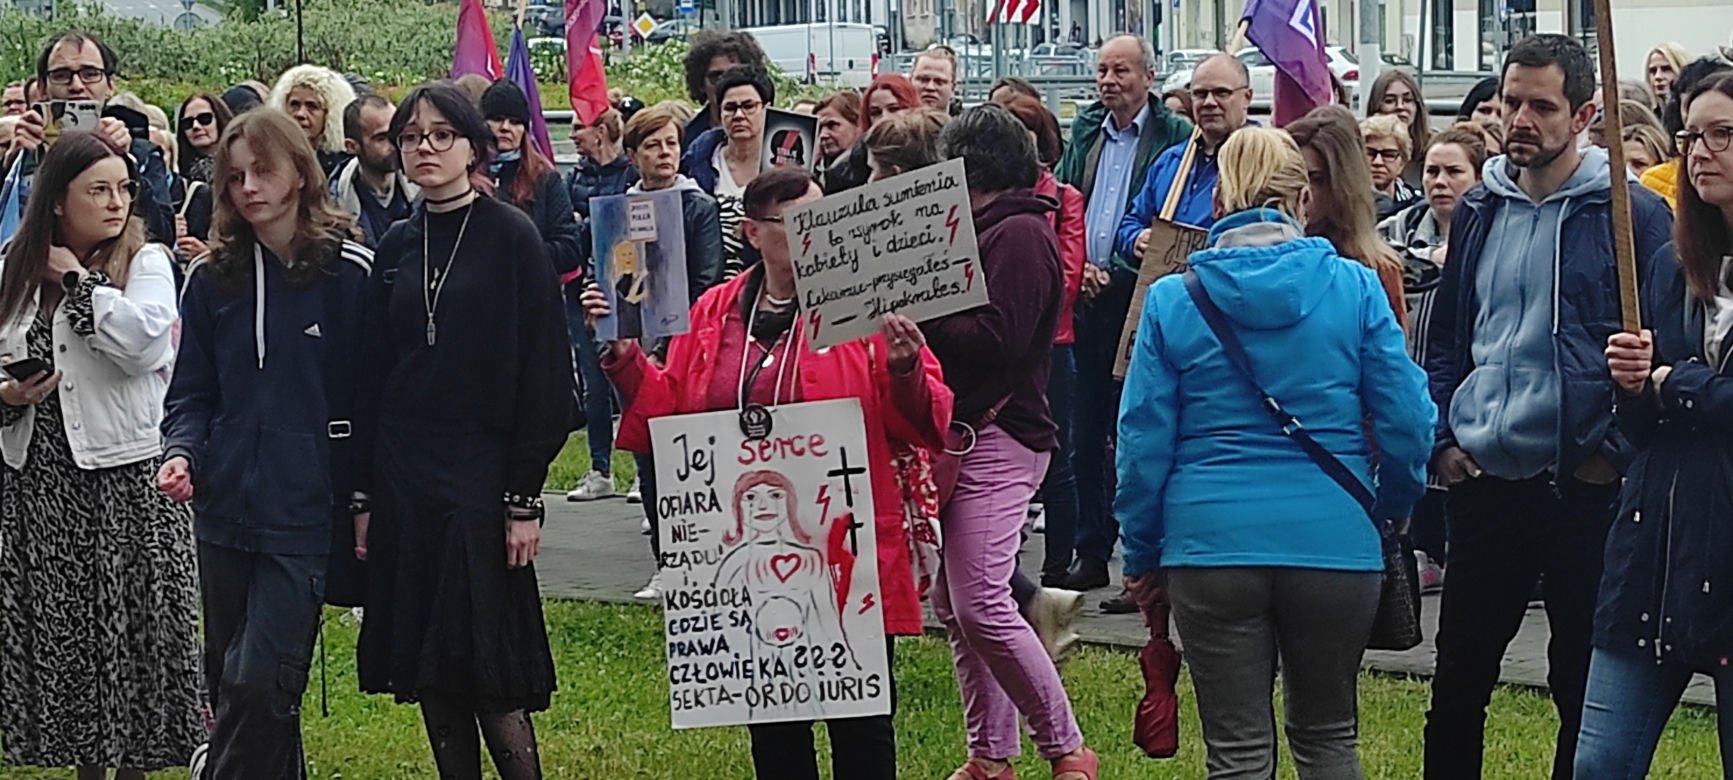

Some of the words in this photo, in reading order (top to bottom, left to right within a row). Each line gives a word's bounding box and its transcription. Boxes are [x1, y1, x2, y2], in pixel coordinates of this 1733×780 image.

[793, 193, 879, 235] Klauzula
[883, 171, 959, 207] sumienia
[829, 229, 844, 247] to
[848, 209, 904, 246] wyrok
[915, 202, 945, 217] na
[794, 246, 859, 280] kobiety
[872, 239, 882, 257] i
[886, 225, 943, 254] dzieci.
[673, 433, 716, 486] Jej
[737, 432, 829, 465] serce
[659, 487, 722, 520] OFIARA
[671, 518, 711, 544] NIE-
[665, 580, 753, 611] KOŚCIOŁA
[728, 609, 753, 634] SĄ
[669, 634, 730, 659] PRAWA
[669, 652, 788, 685] CZŁOWIEKA
[672, 682, 811, 711] SEKTA-ORDO
[818, 673, 881, 702] IURIS
